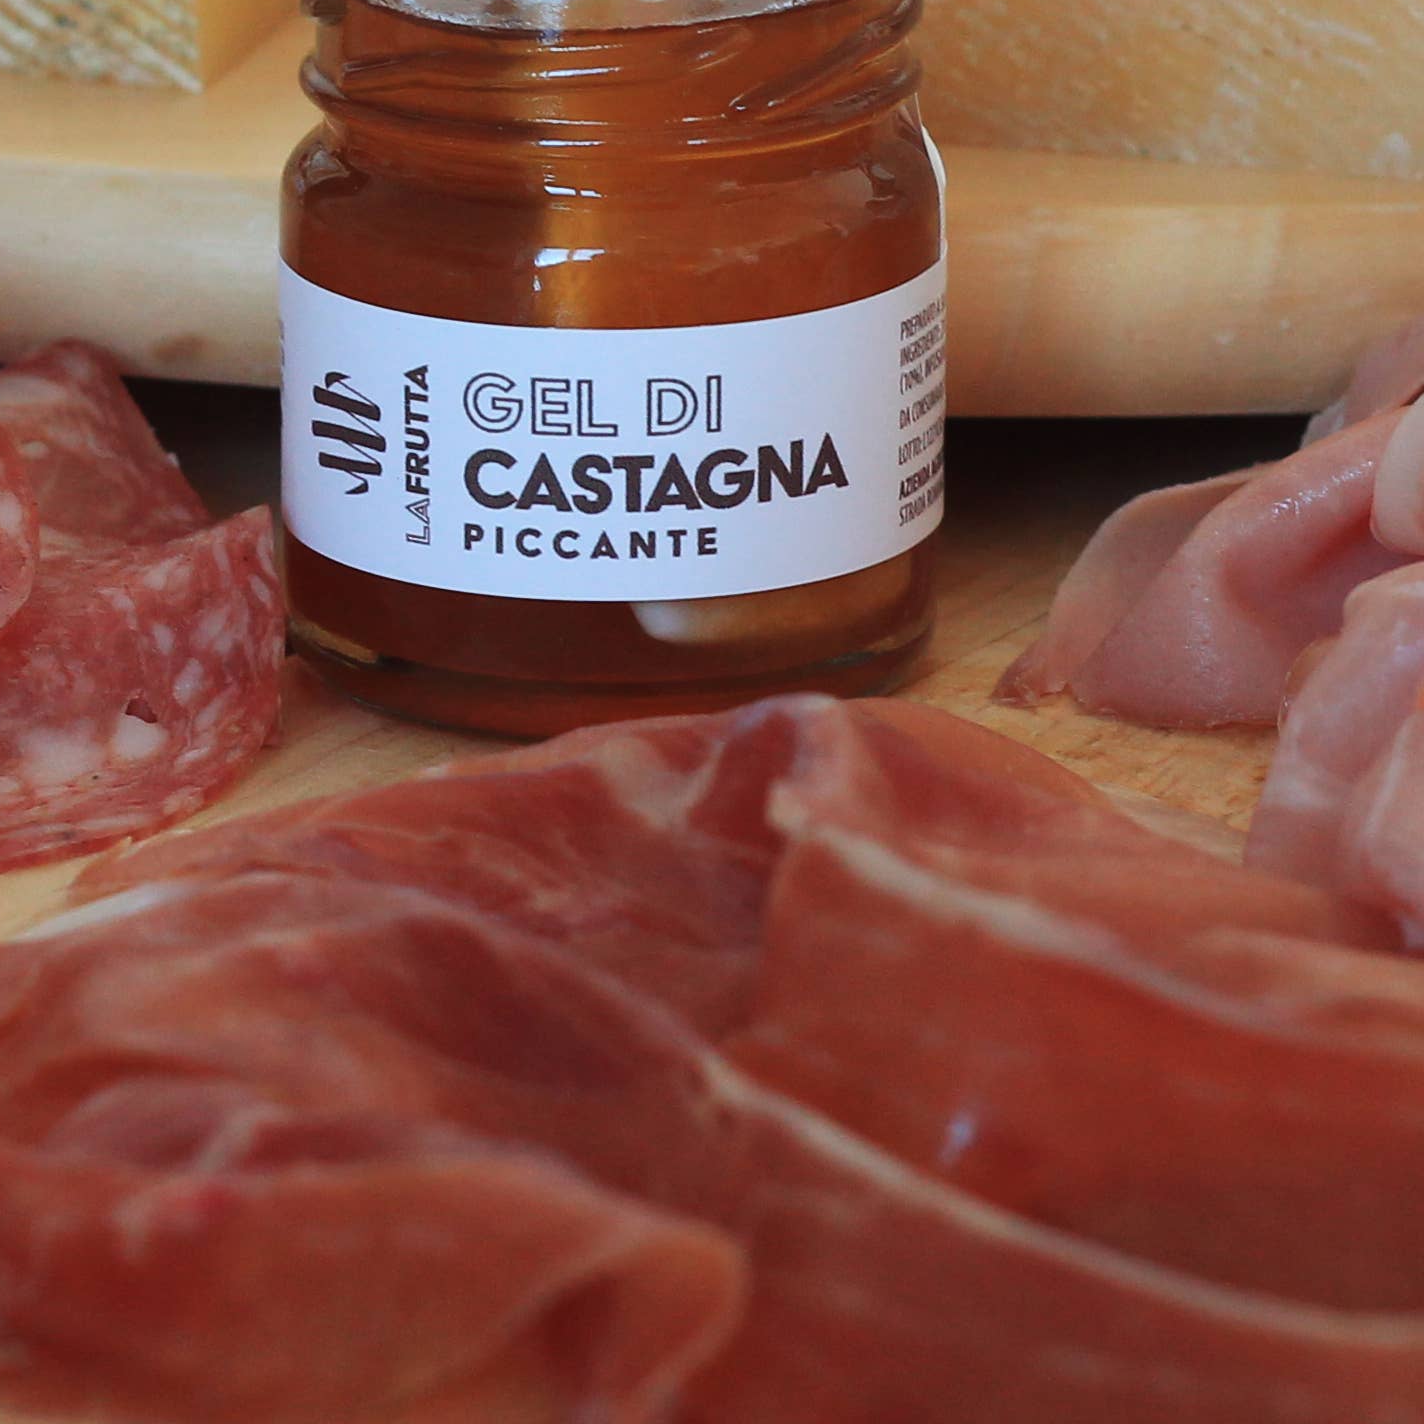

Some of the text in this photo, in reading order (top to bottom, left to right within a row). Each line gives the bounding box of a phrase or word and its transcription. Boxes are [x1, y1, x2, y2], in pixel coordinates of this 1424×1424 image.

[463, 372, 722, 437] GEL DI
[463, 432, 849, 514] CASTAGNA
[463, 523, 718, 559] PICCANTE
